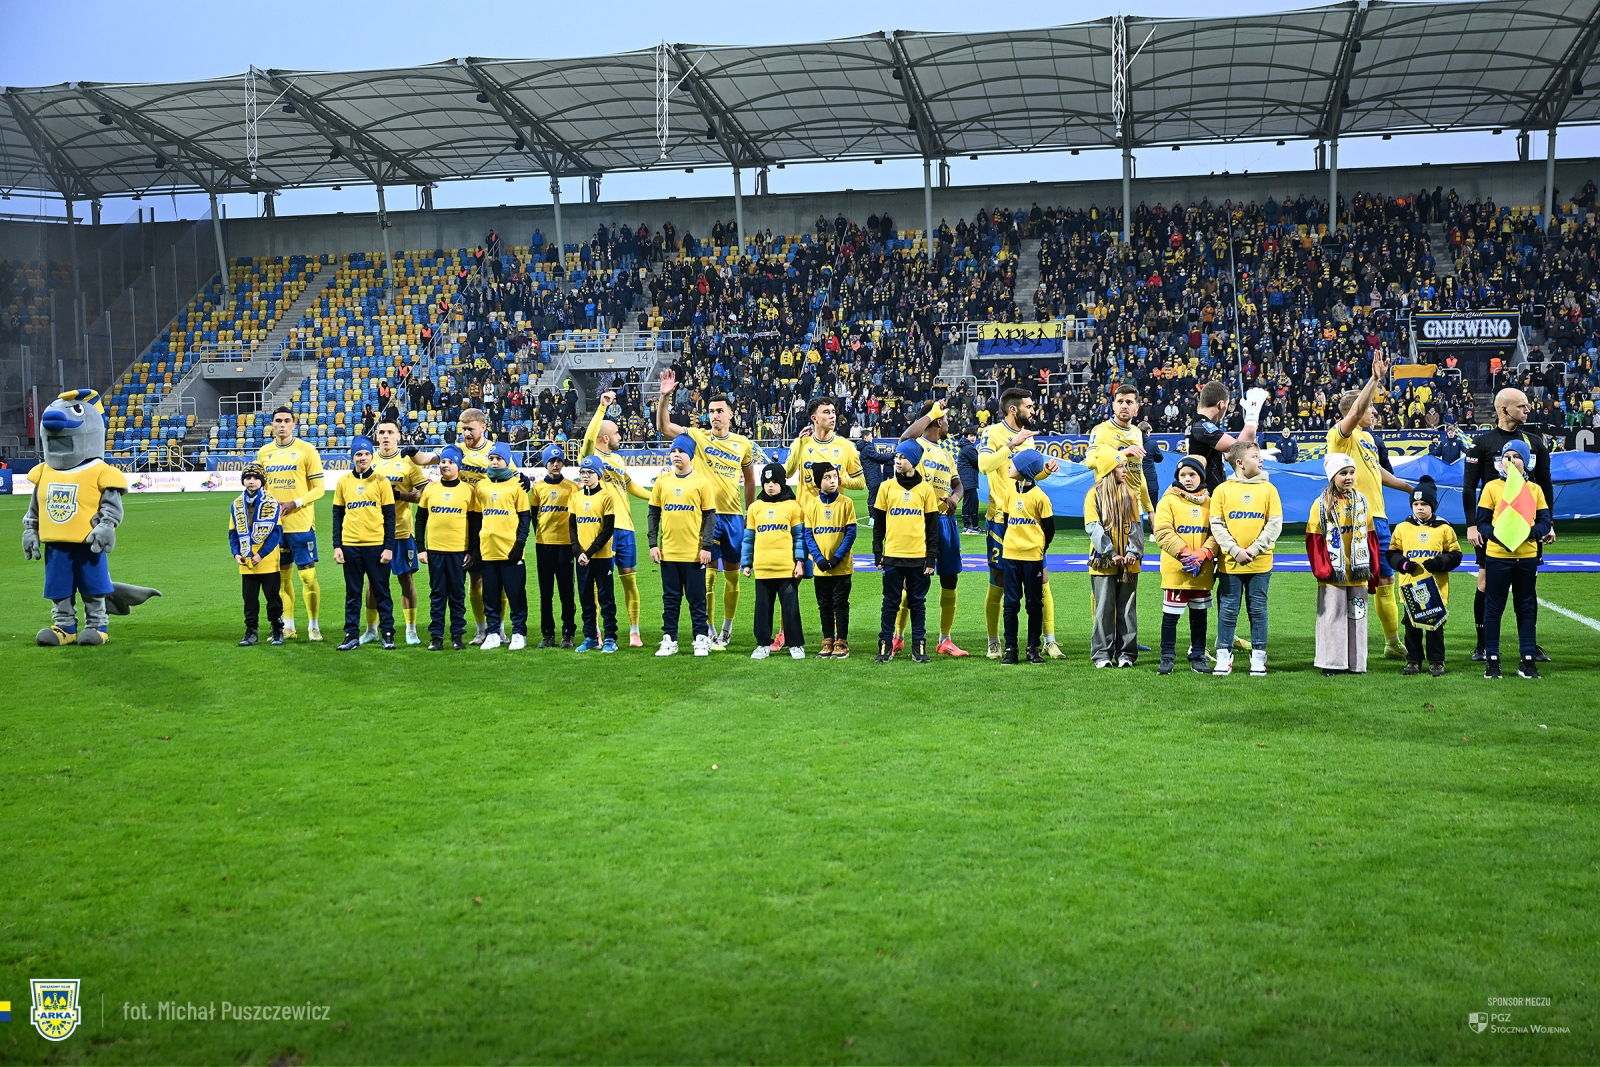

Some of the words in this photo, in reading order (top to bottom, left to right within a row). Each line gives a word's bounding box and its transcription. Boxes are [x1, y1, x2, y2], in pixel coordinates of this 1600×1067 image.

[1423, 319, 1512, 338] GNIEWINO
[991, 327, 1051, 349] ARKA
[573, 354, 582, 365] G
[637, 353, 649, 363] 14
[207, 363, 215, 374] G
[704, 446, 741, 463] GDYNIA
[266, 464, 298, 472] GDYNIA
[273, 477, 296, 486] Energa
[347, 500, 378, 510] GDYNIA
[431, 505, 462, 514] GDYNIA
[664, 503, 695, 512] GDYNIA
[483, 508, 510, 516] GDYNIA
[889, 507, 923, 517] GDYNIA
[1228, 510, 1266, 520] GDYNIA
[757, 523, 789, 534] GDYNIA
[814, 525, 845, 535] GDYNIA
